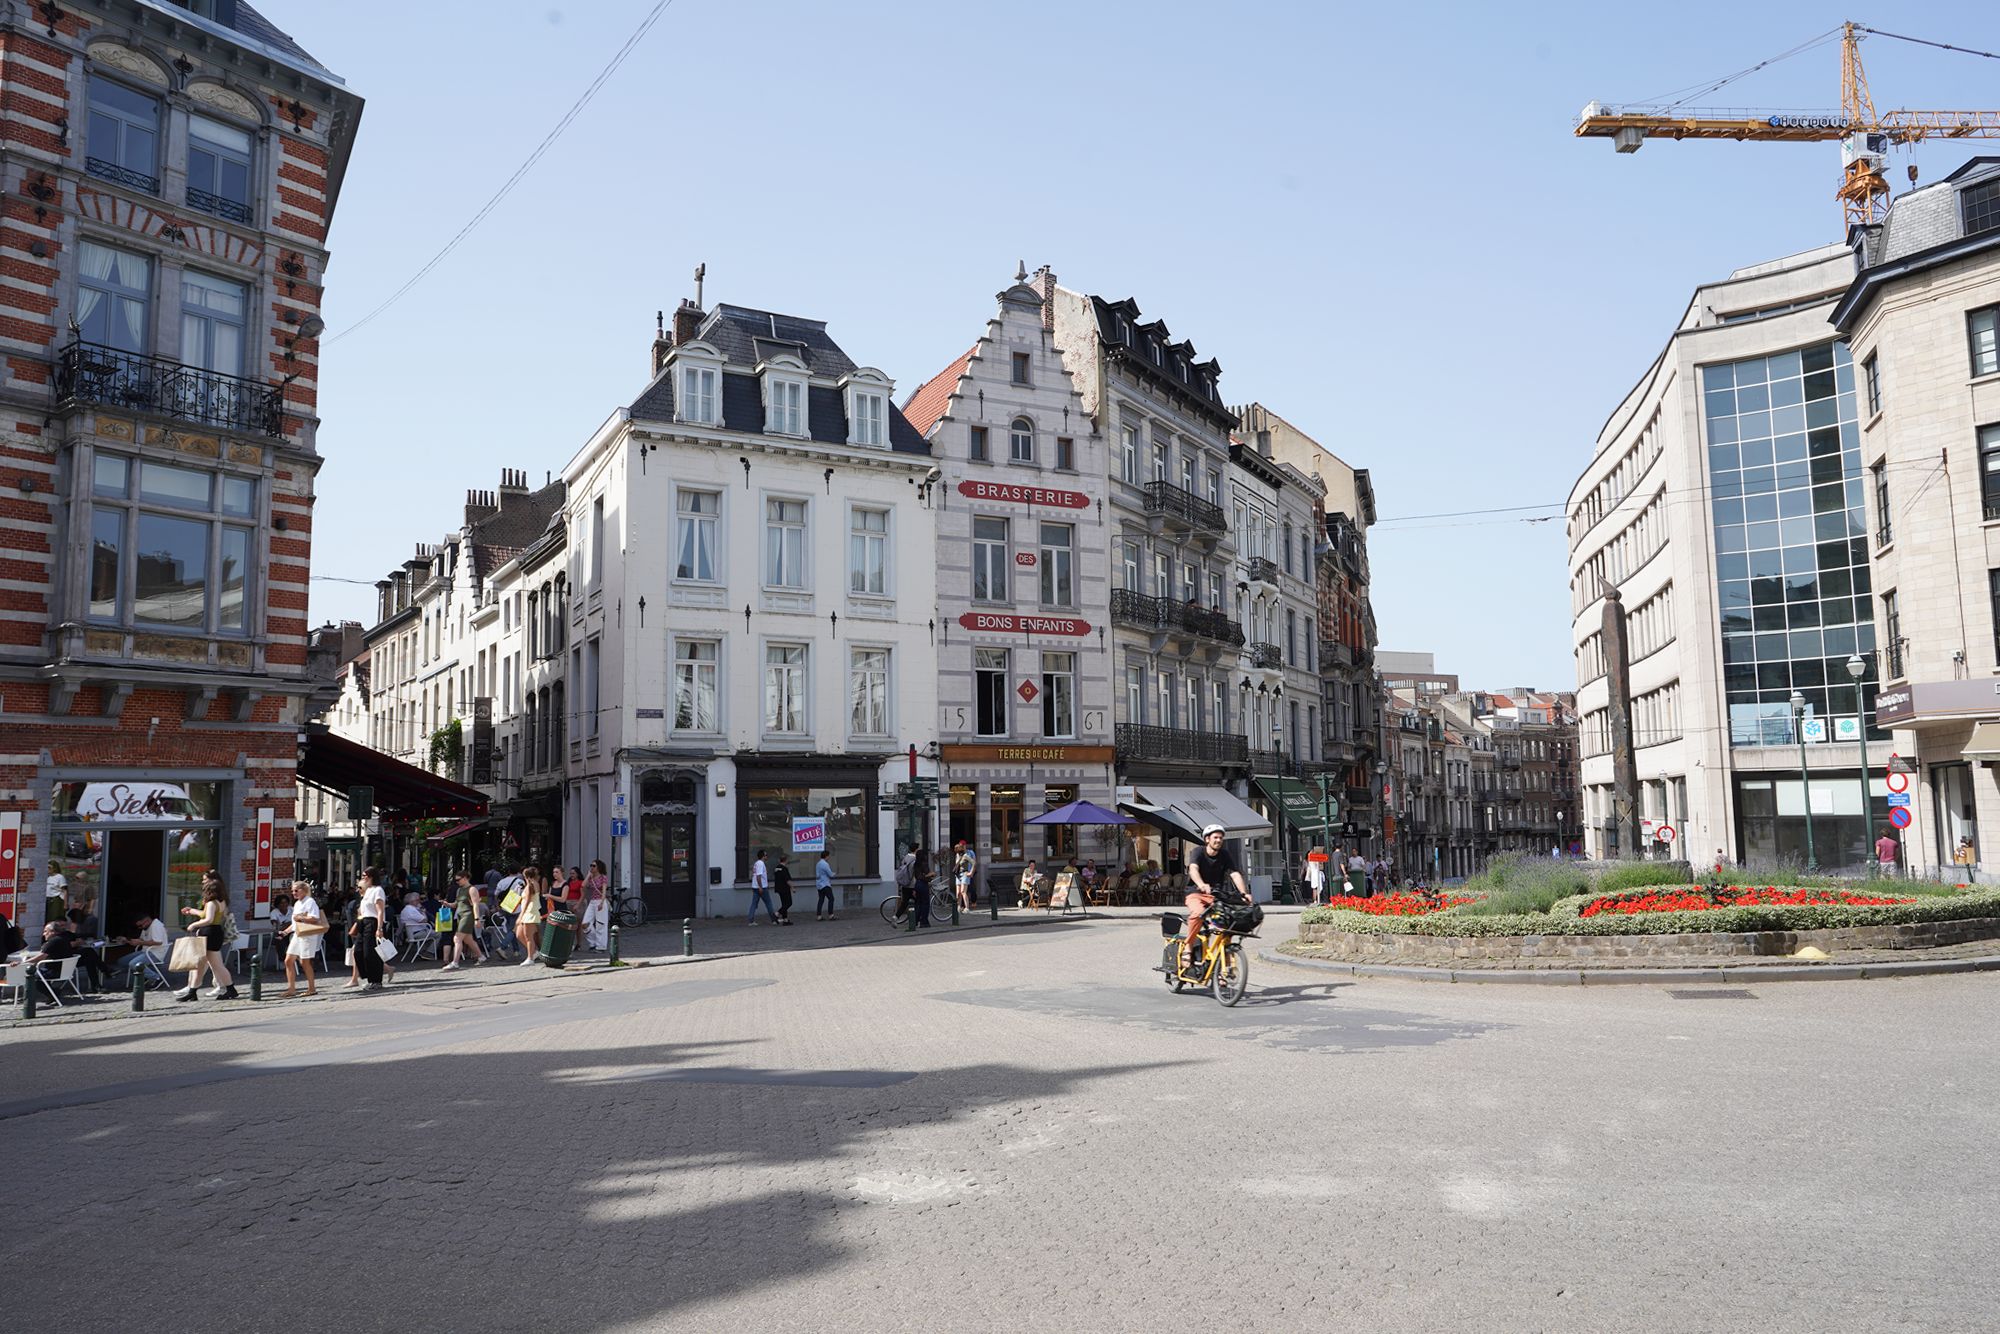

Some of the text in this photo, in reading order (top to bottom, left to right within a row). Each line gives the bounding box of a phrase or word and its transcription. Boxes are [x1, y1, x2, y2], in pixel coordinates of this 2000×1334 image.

[1780, 117, 1848, 127] Herpain
[977, 484, 1073, 505] BRASSERIE
[1018, 553, 1034, 563] DES
[977, 616, 1075, 633] BONS ENFANTS
[998, 748, 1031, 760] TERRES
[1042, 746, 1065, 760] CAFÉ
[796, 825, 822, 843] LOUÉ
